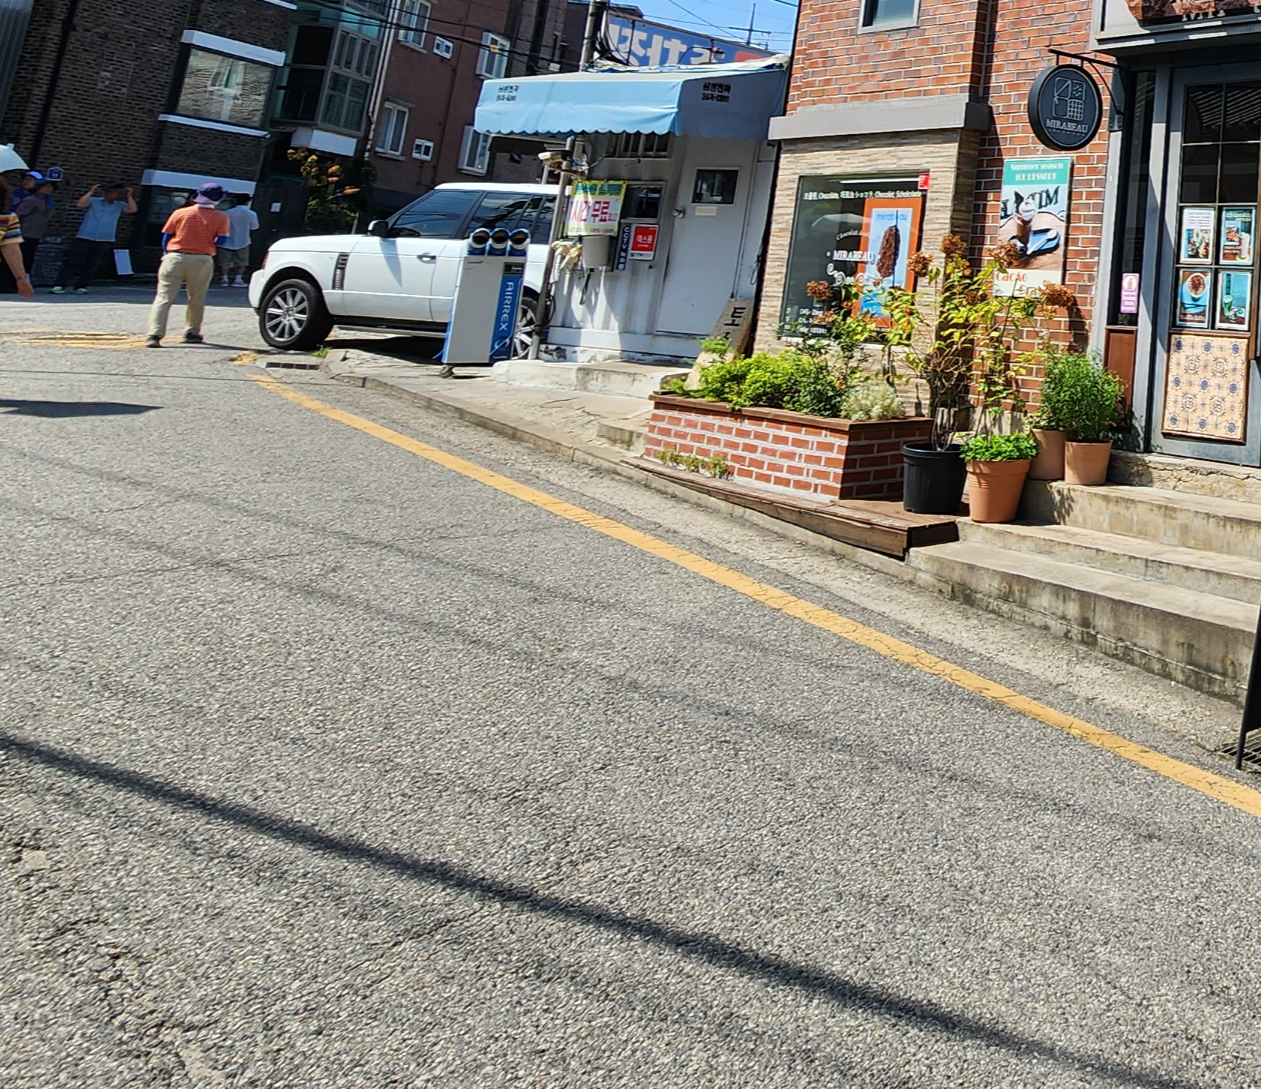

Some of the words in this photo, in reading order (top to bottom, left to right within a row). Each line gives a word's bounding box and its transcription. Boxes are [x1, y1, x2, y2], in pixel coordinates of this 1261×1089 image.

[1045, 119, 1089, 133] MIRABEAU
[876, 213, 908, 221] mirabau
[622, 226, 630, 249] CCTV
[833, 250, 873, 262] MIRABEAU
[499, 282, 514, 331] AIRREX
